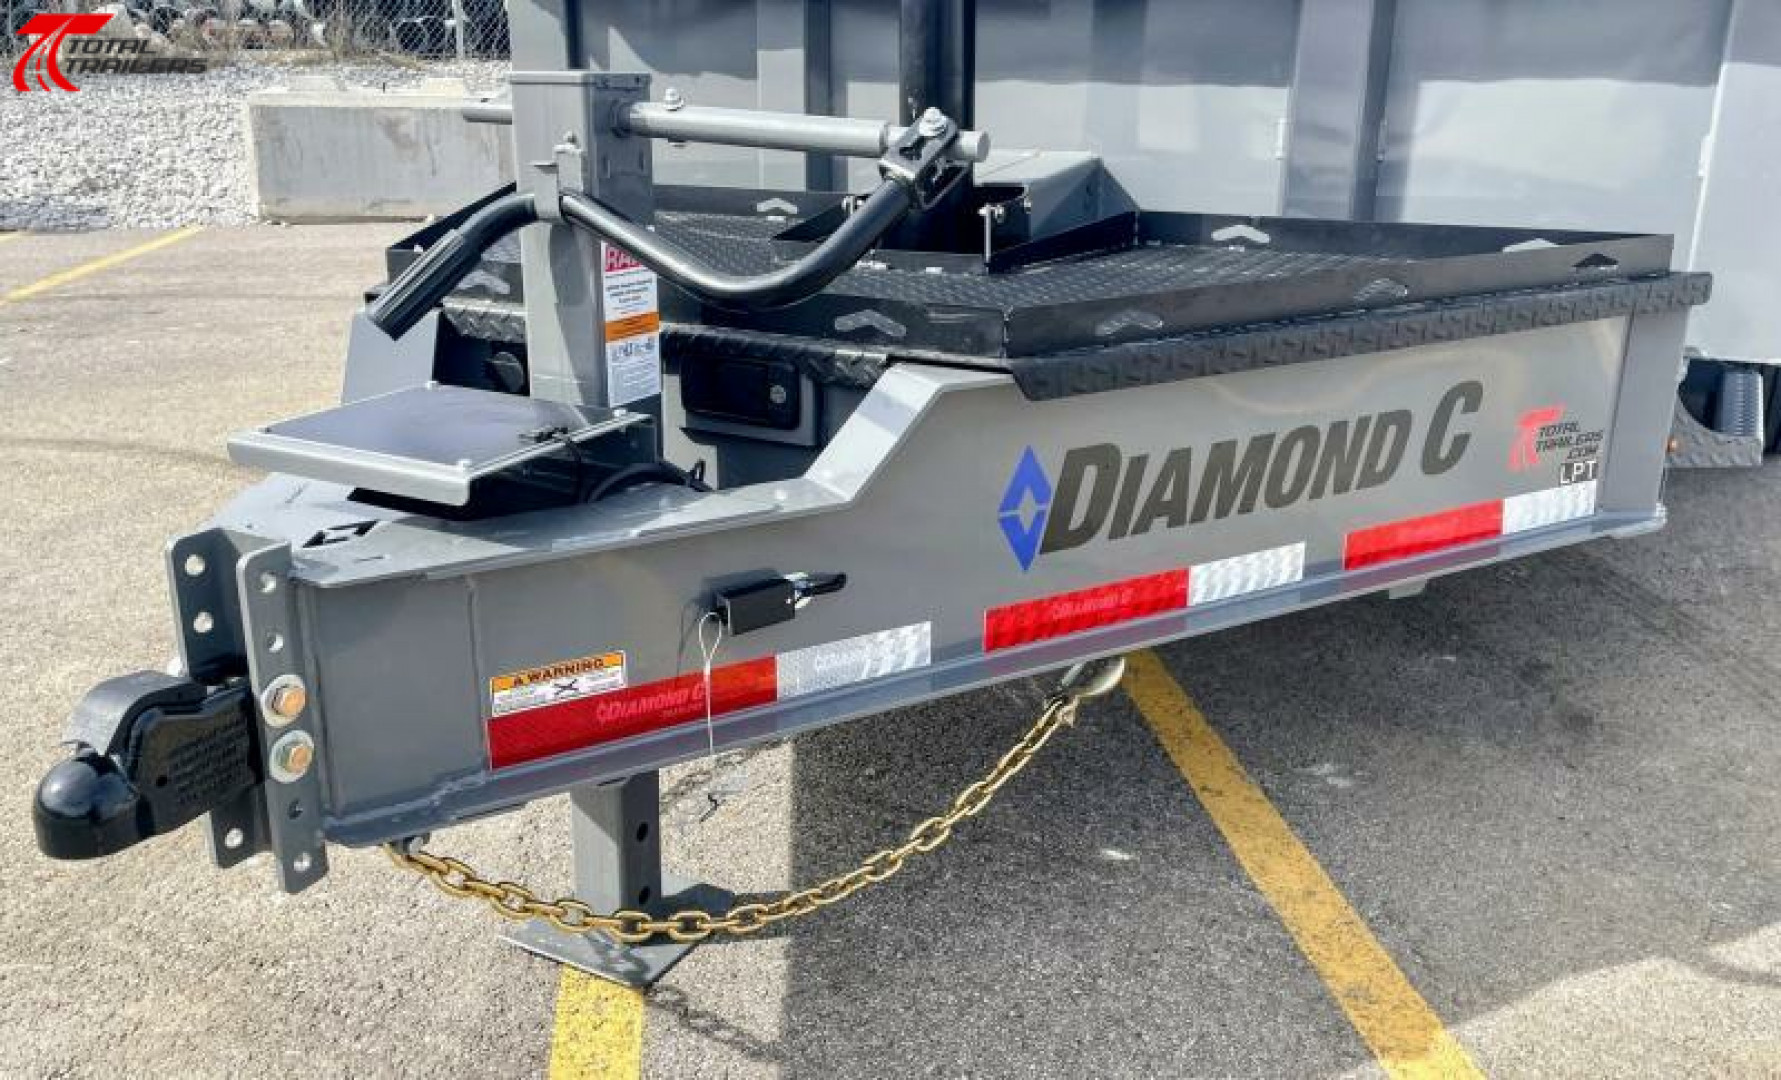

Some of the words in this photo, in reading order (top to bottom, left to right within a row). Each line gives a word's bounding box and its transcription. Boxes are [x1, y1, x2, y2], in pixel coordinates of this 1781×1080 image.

[1039, 409, 1413, 556] DIAMOND
[1421, 380, 1485, 476] C
[1560, 460, 1598, 485] LPT
[527, 658, 604, 682] WARNING
